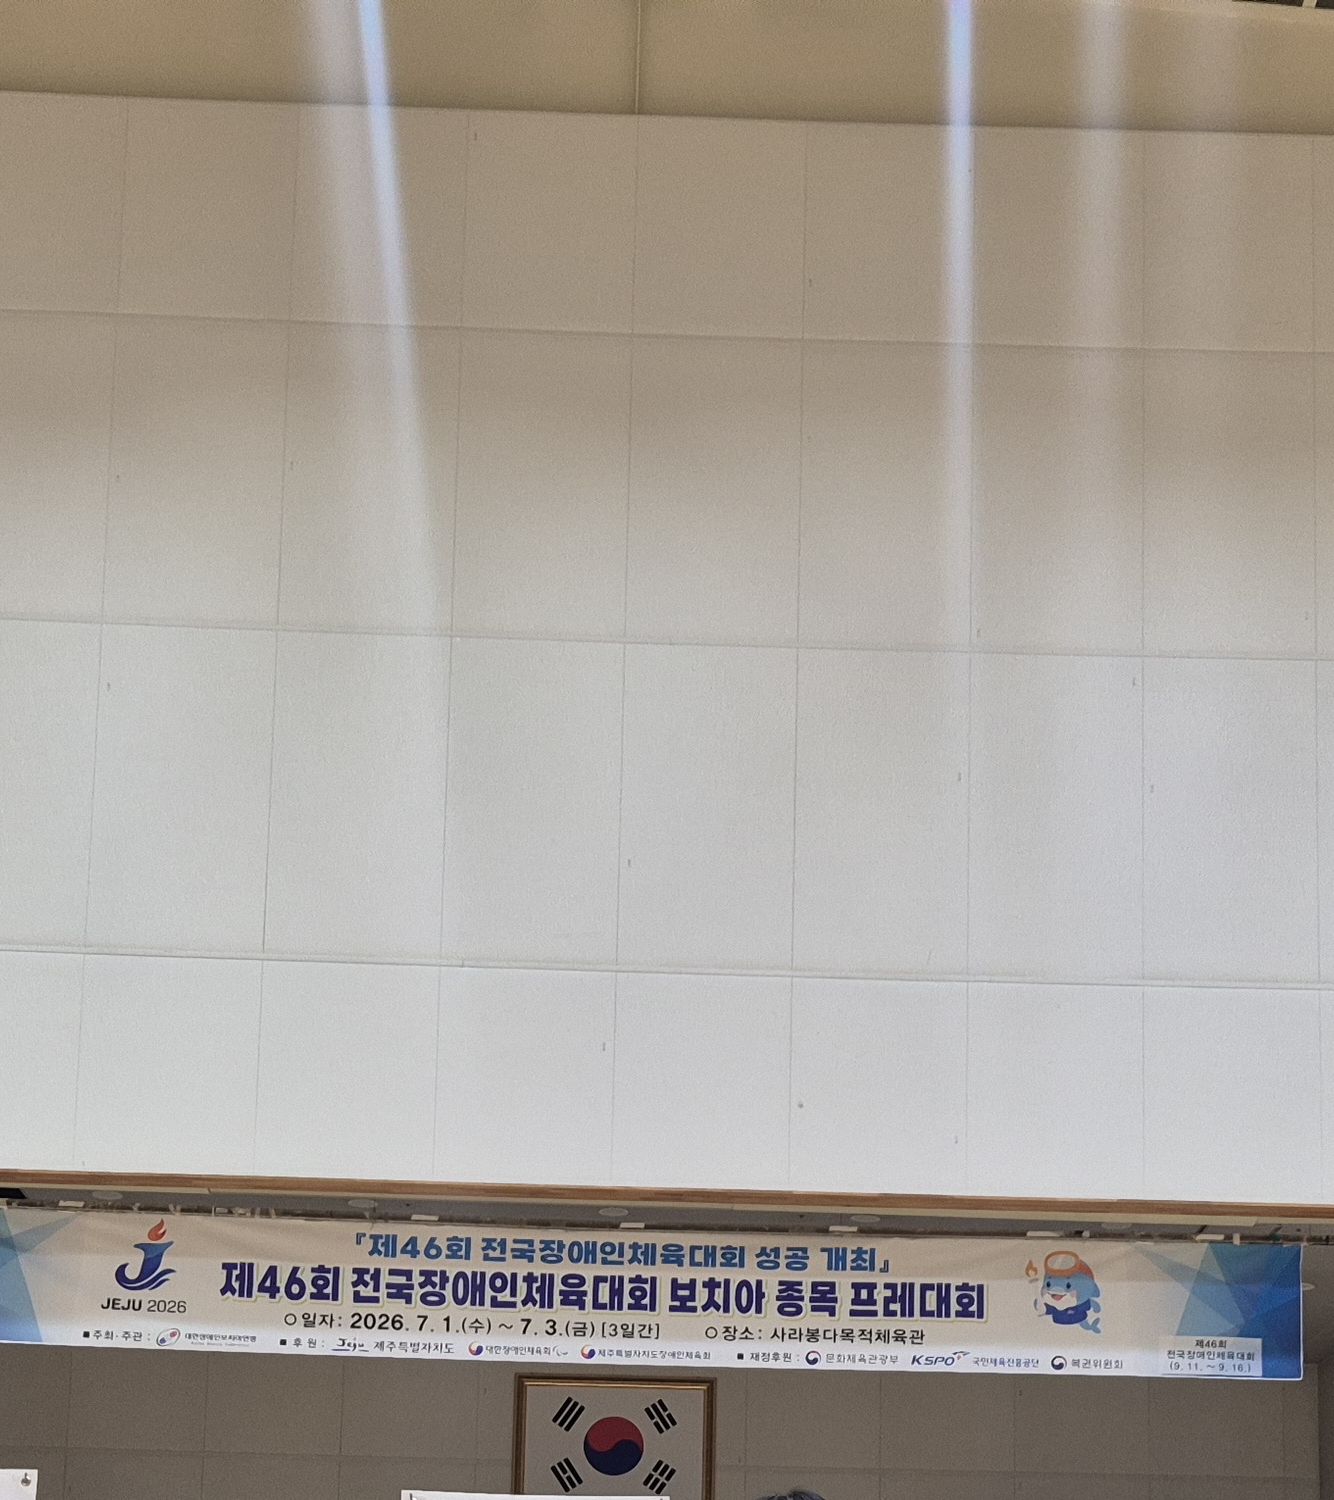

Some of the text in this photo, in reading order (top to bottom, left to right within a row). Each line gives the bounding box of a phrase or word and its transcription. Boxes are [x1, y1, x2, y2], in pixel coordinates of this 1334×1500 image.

[356, 1232, 890, 1273] 『제46회 전국장애인체육대회 성공 개최』
[219, 1262, 985, 1320] 제46회 전국장애인체육대회 보치아 종목 프레대회
[100, 1298, 187, 1314] JEJU 2026
[350, 1312, 409, 1332] 2026.
[602, 1322, 660, 1340] [3일간]
[770, 1327, 926, 1345] 사라봉다목적체육관
[373, 1340, 455, 1354] 제주특별자치도
[485, 1345, 552, 1356] 대한장애인체육회
[1195, 1339, 1227, 1349] 제46회
[597, 1348, 711, 1360] 제주특별자치도장애인체육회
[749, 1352, 792, 1363] 재정후원
[825, 1353, 899, 1365] 문화체육관광부
[910, 1354, 956, 1367] KSPO
[1167, 1350, 1255, 1362] 전국장애인체육대회
[972, 1357, 1040, 1368] 국민체육진흥공단
[1071, 1358, 1124, 1370] 복권위원회
